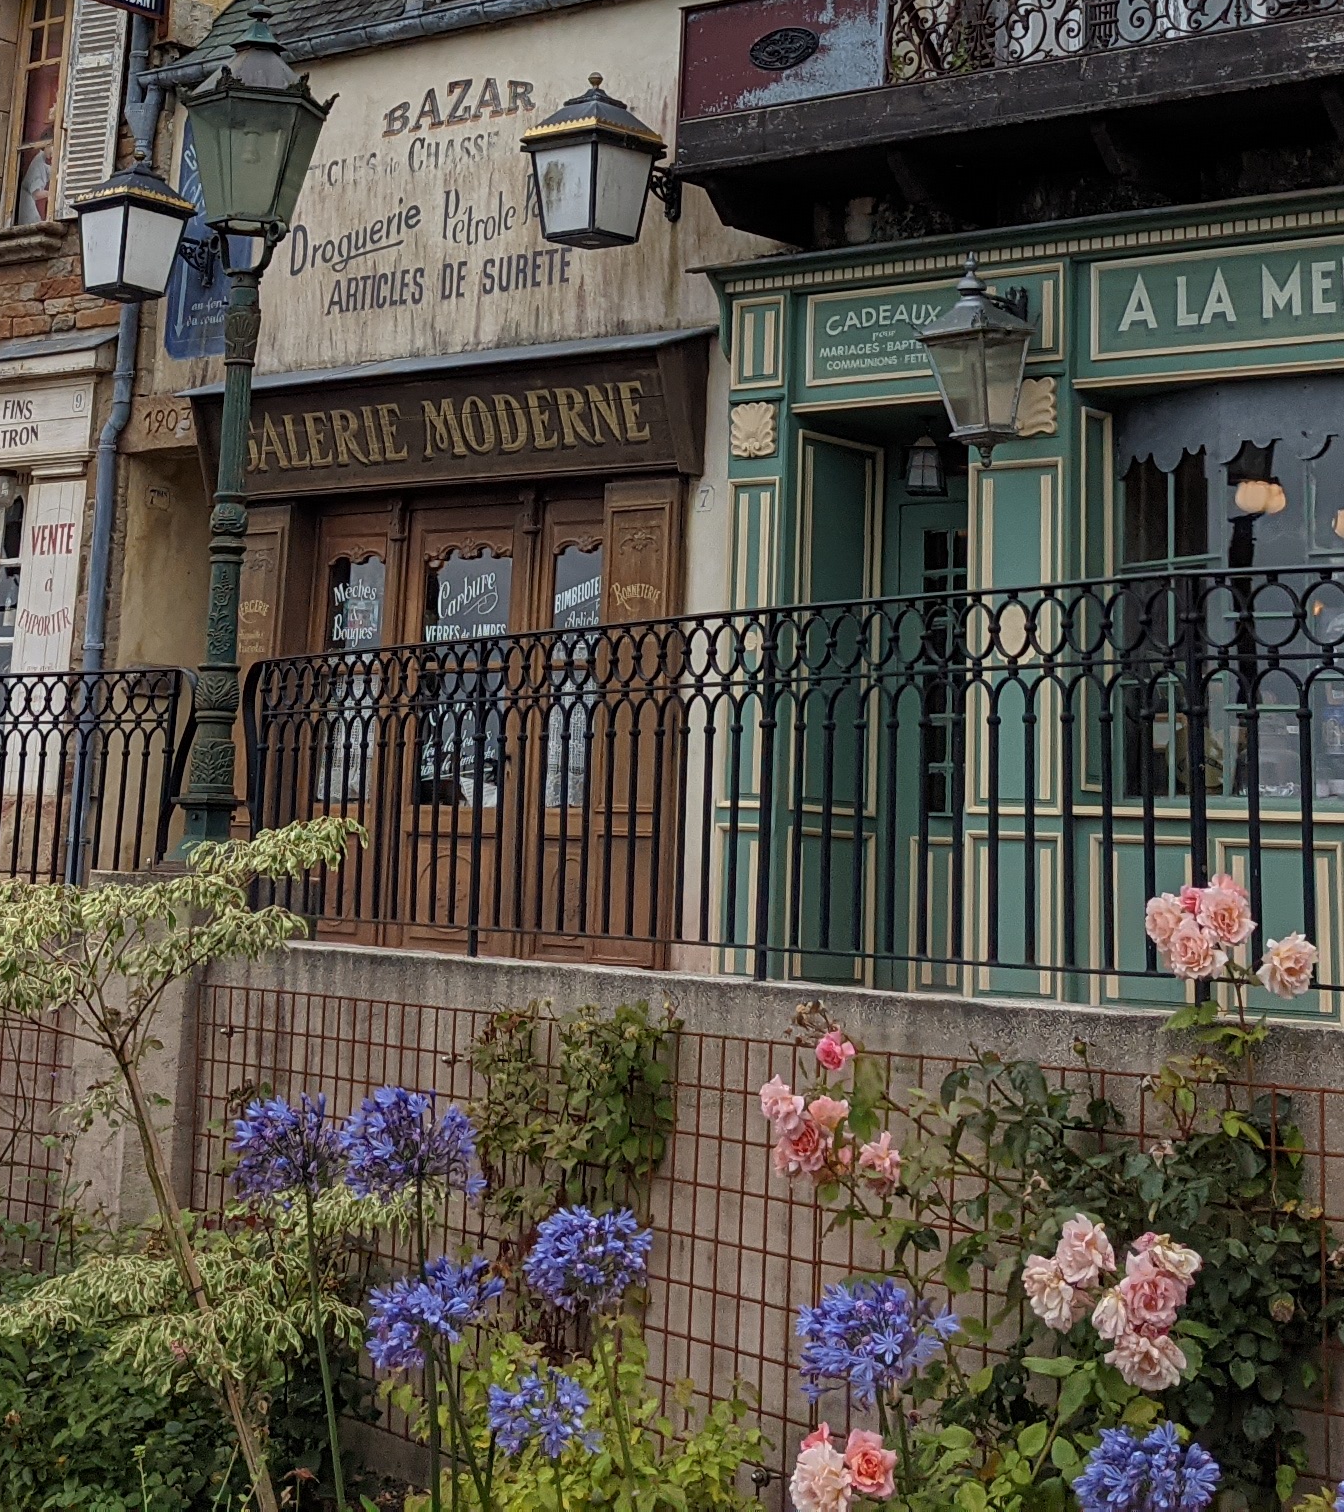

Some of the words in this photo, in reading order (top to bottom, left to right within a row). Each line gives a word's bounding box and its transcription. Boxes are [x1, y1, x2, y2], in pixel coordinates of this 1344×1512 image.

[381, 77, 537, 139] BAZAR
[289, 197, 422, 276] Droguerie
[442, 187, 518, 247] Pétrole
[324, 265, 426, 317] ARTICLES
[439, 260, 468, 302] DE
[482, 246, 573, 296] SURETE
[1117, 273, 1158, 332] A
[1176, 266, 1238, 327] LA
[825, 304, 942, 336] CADEAUX
[819, 342, 880, 358] MARIAGES
[872, 330, 896, 342] pour
[826, 356, 898, 370] COMMUNIONS
[2, 399, 34, 421] FINS
[73, 394, 83, 410] 9
[422, 380, 652, 460] MODERNE
[698, 489, 710, 508] 7
[31, 522, 76, 556] VENTE
[334, 578, 377, 606] Mèches
[437, 572, 498, 618] Carbure
[18, 606, 72, 637] EMPORTER
[333, 614, 377, 647] Bougies
[425, 624, 460, 643] VERRES
[472, 623, 507, 638] LAMPES
